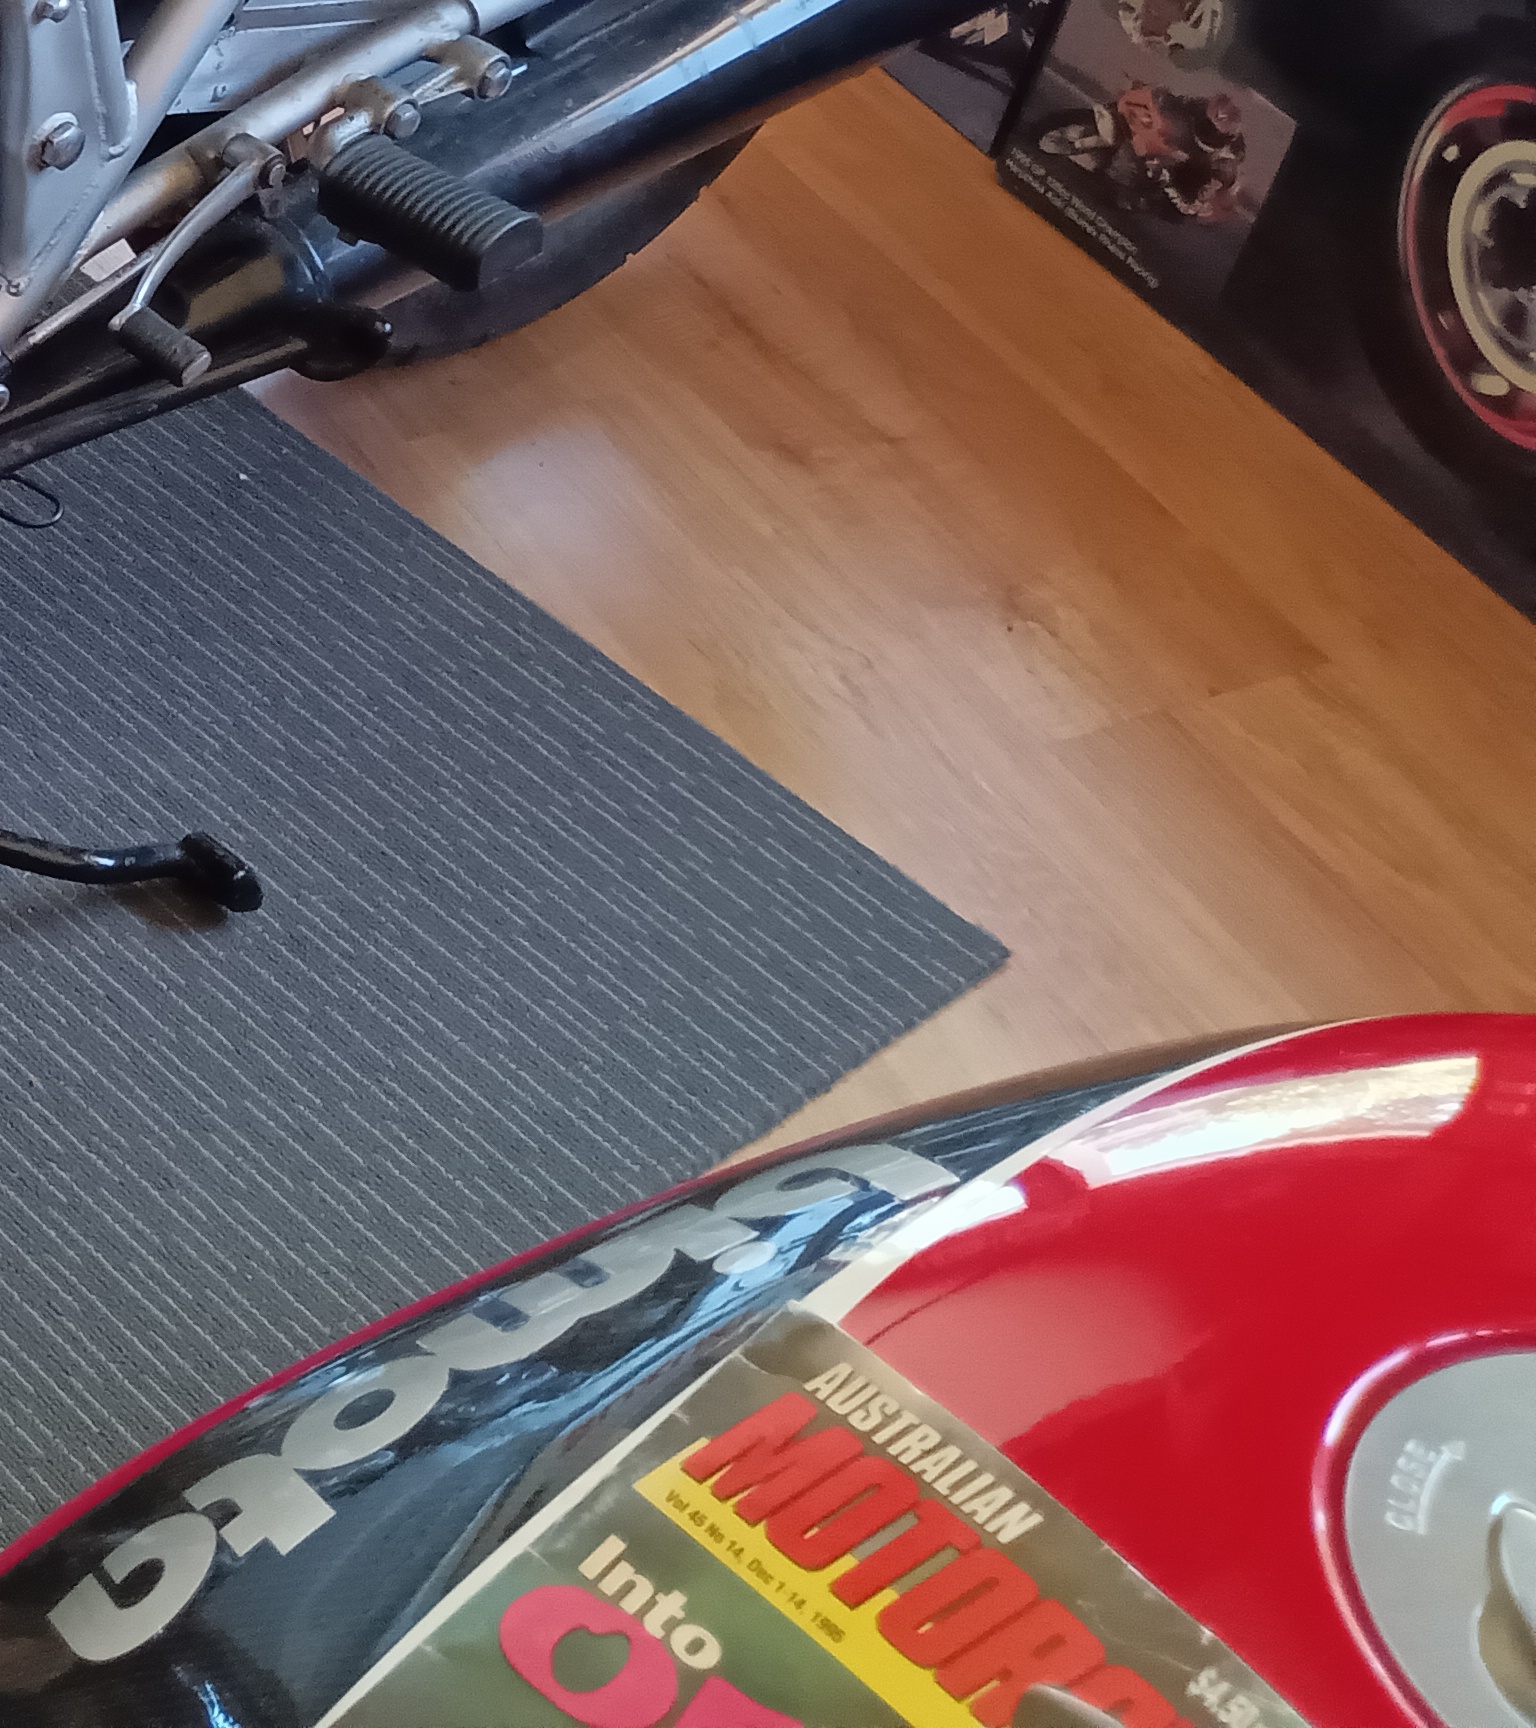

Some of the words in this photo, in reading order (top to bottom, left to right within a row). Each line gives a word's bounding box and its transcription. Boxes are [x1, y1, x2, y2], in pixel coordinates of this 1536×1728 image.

[46, 1143, 960, 1663] bimota
[803, 1361, 1045, 1545] AUSTRALIAN
[578, 1533, 723, 1671] Into
[665, 1488, 689, 1516] Vol
[704, 1523, 725, 1545] No
[747, 1556, 775, 1586] Dec
